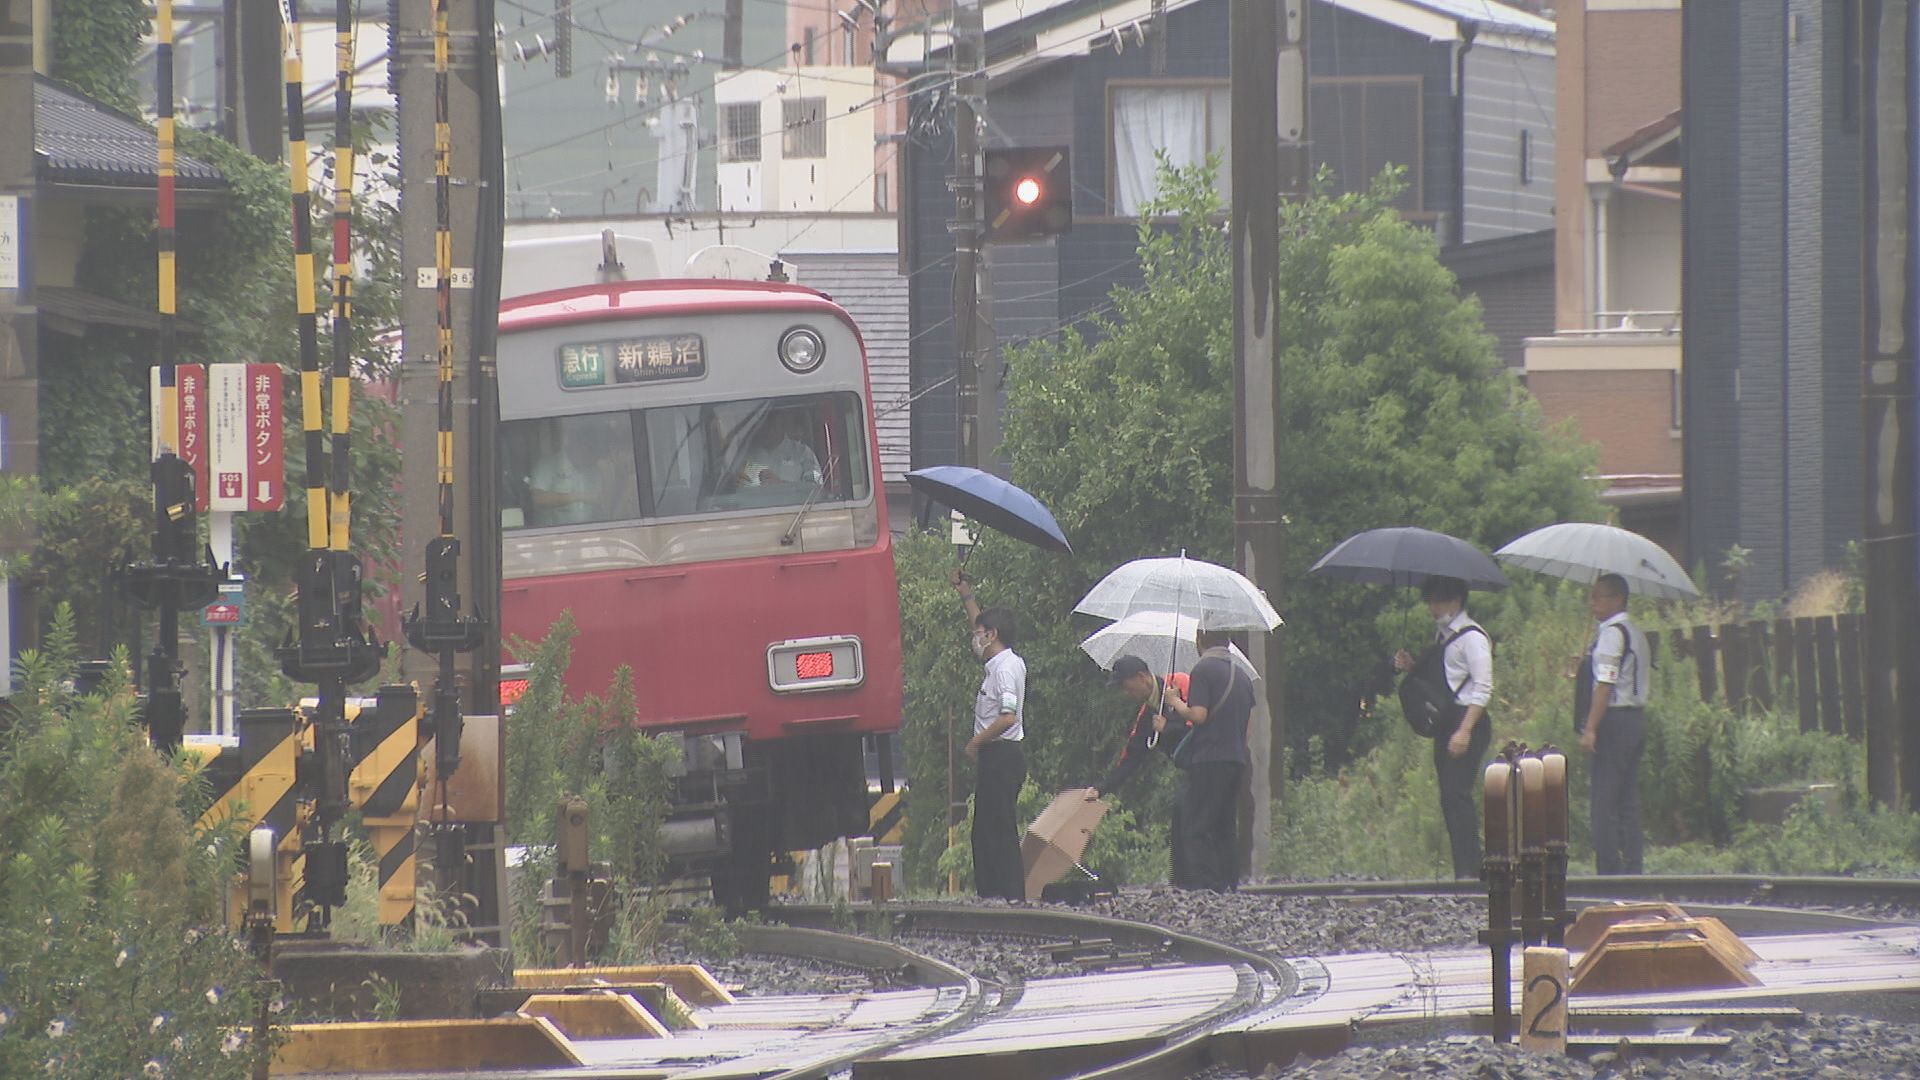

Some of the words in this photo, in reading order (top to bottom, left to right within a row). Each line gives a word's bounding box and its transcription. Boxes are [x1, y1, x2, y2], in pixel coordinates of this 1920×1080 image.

[563, 346, 600, 374] 急行
[617, 337, 701, 369] 新鵜沼
[183, 375, 197, 466] 非常ボタン
[255, 374, 272, 466] 非常ボタン
[221, 474, 240, 482] SOS
[1527, 974, 1562, 1038] 2
